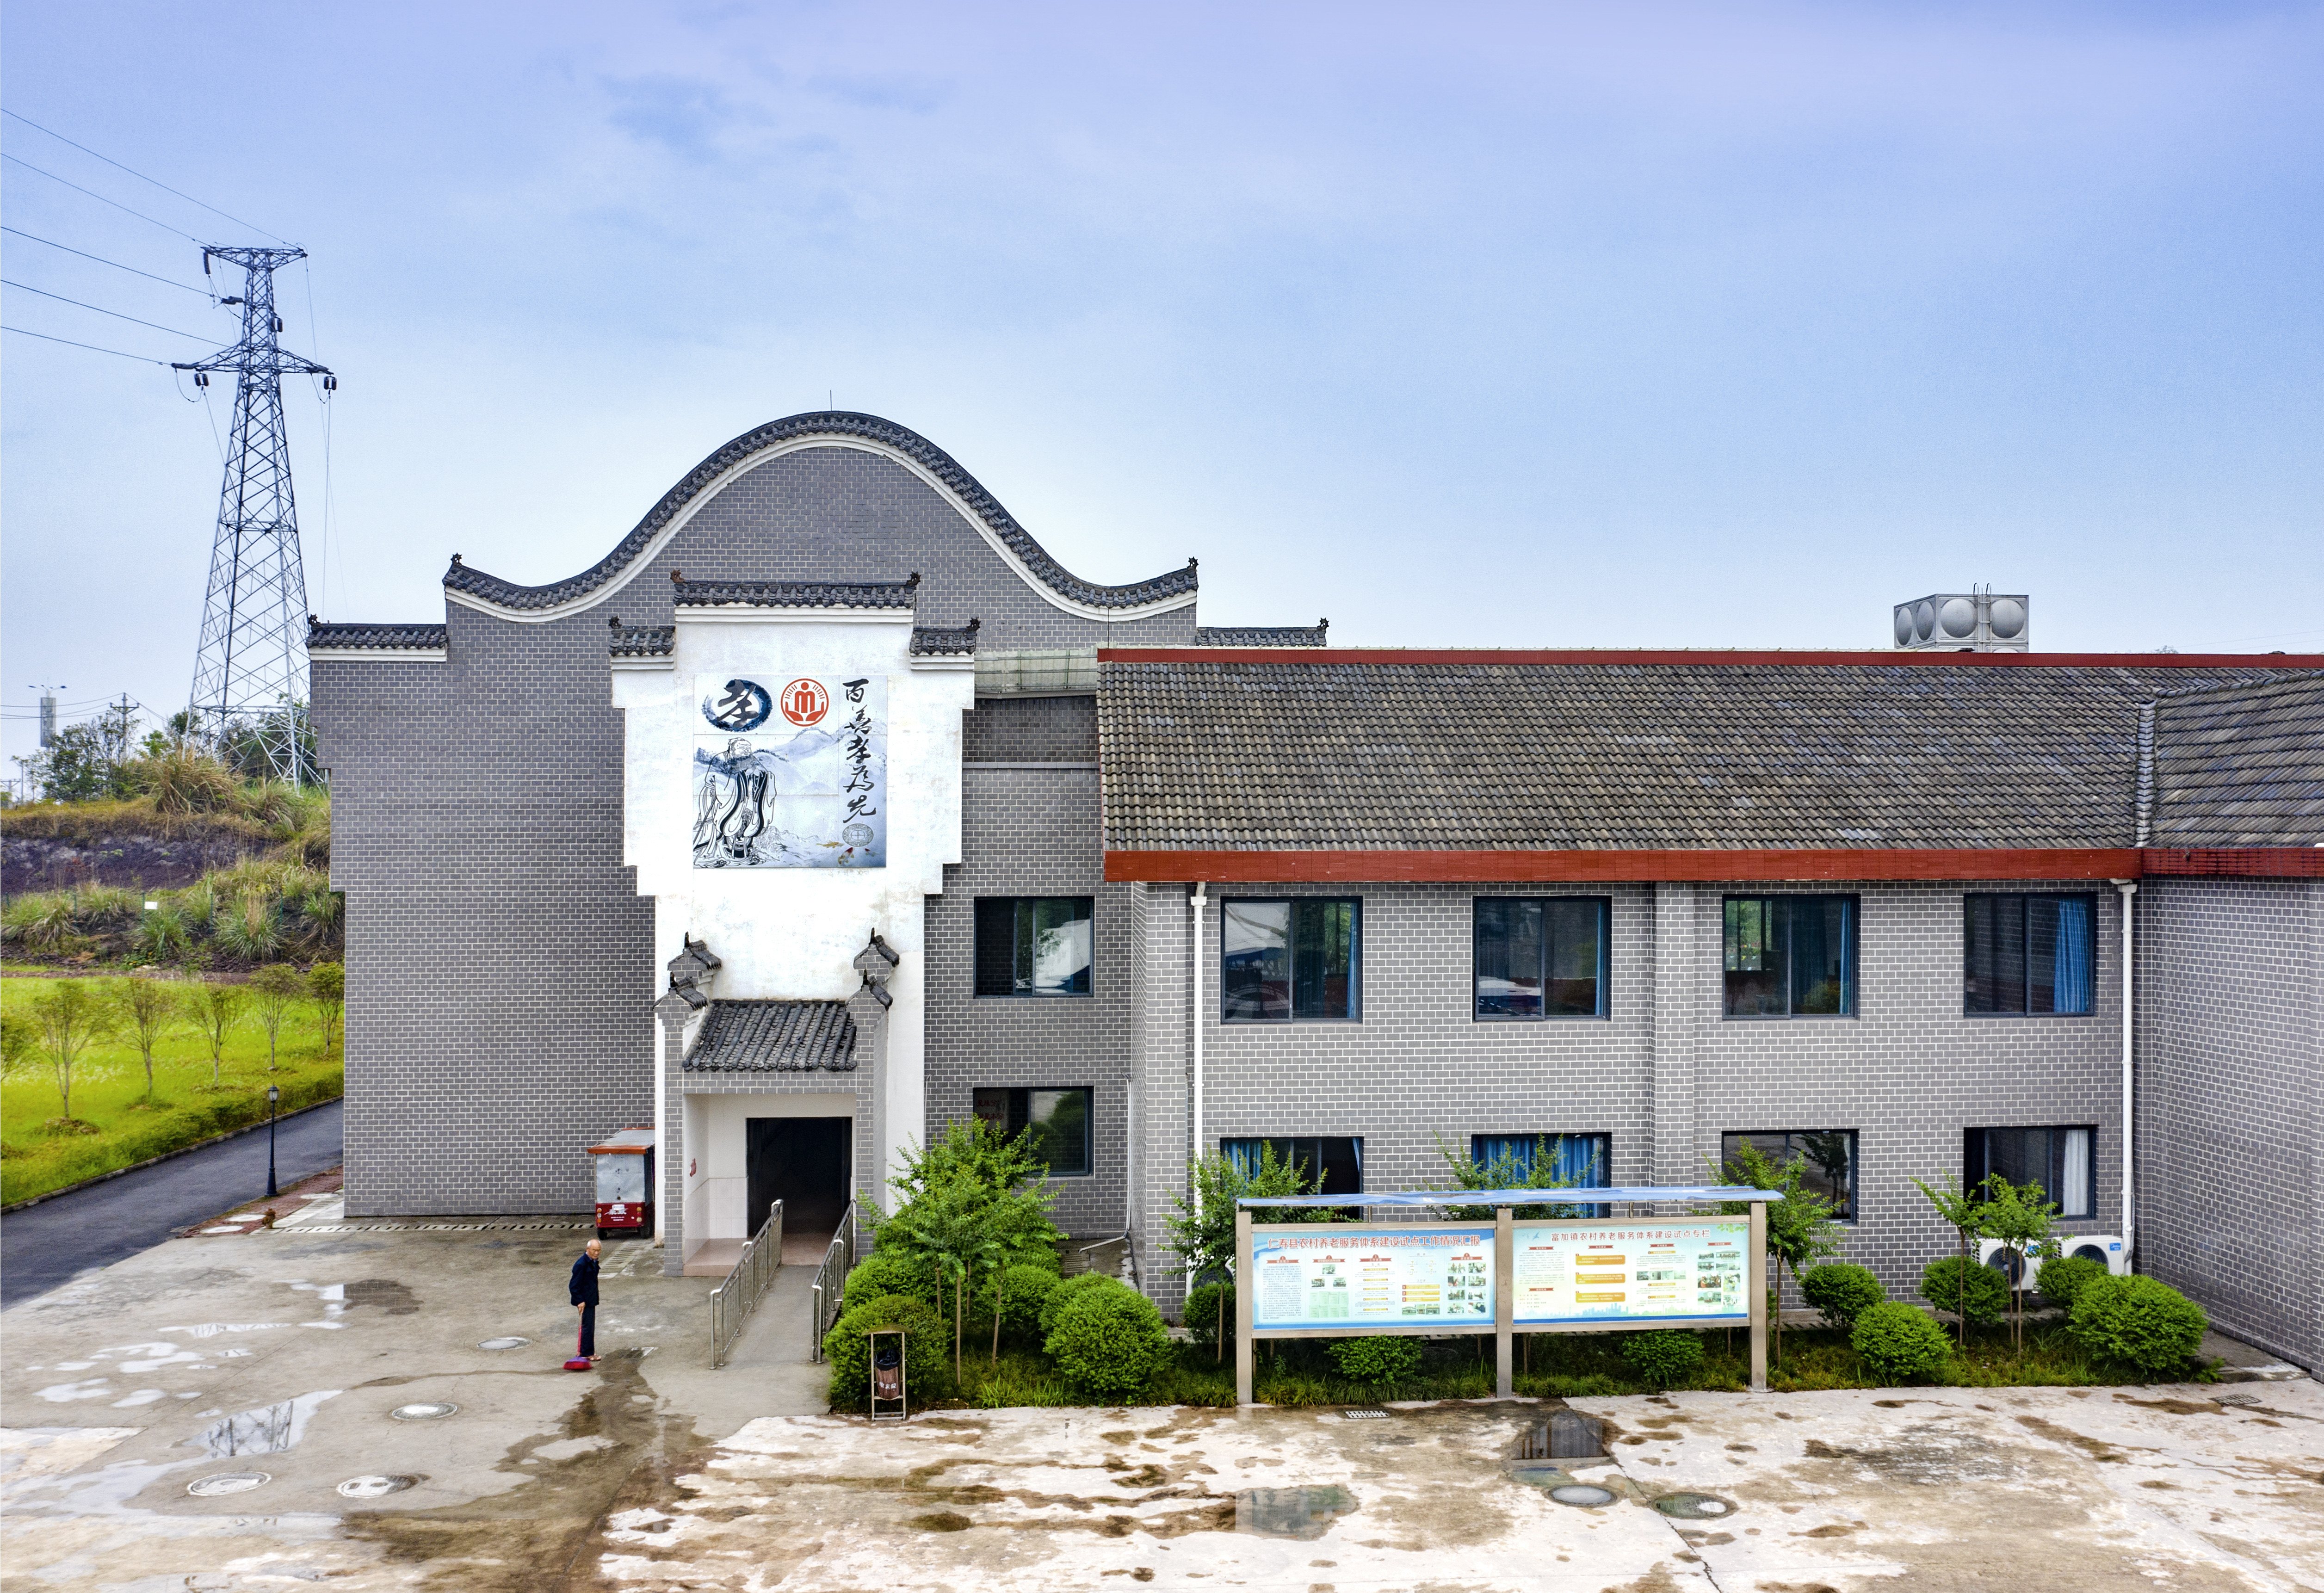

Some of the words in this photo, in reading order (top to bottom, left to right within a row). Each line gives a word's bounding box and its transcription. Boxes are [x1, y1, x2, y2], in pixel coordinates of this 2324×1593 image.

[717, 679, 760, 729] 孝
[1268, 1235, 1480, 1248] 仁寿县农村养老服务体系建设试点工作情况汇报
[1551, 1229, 1709, 1241] 富加镇农村养老服务体系建设试点专栏
